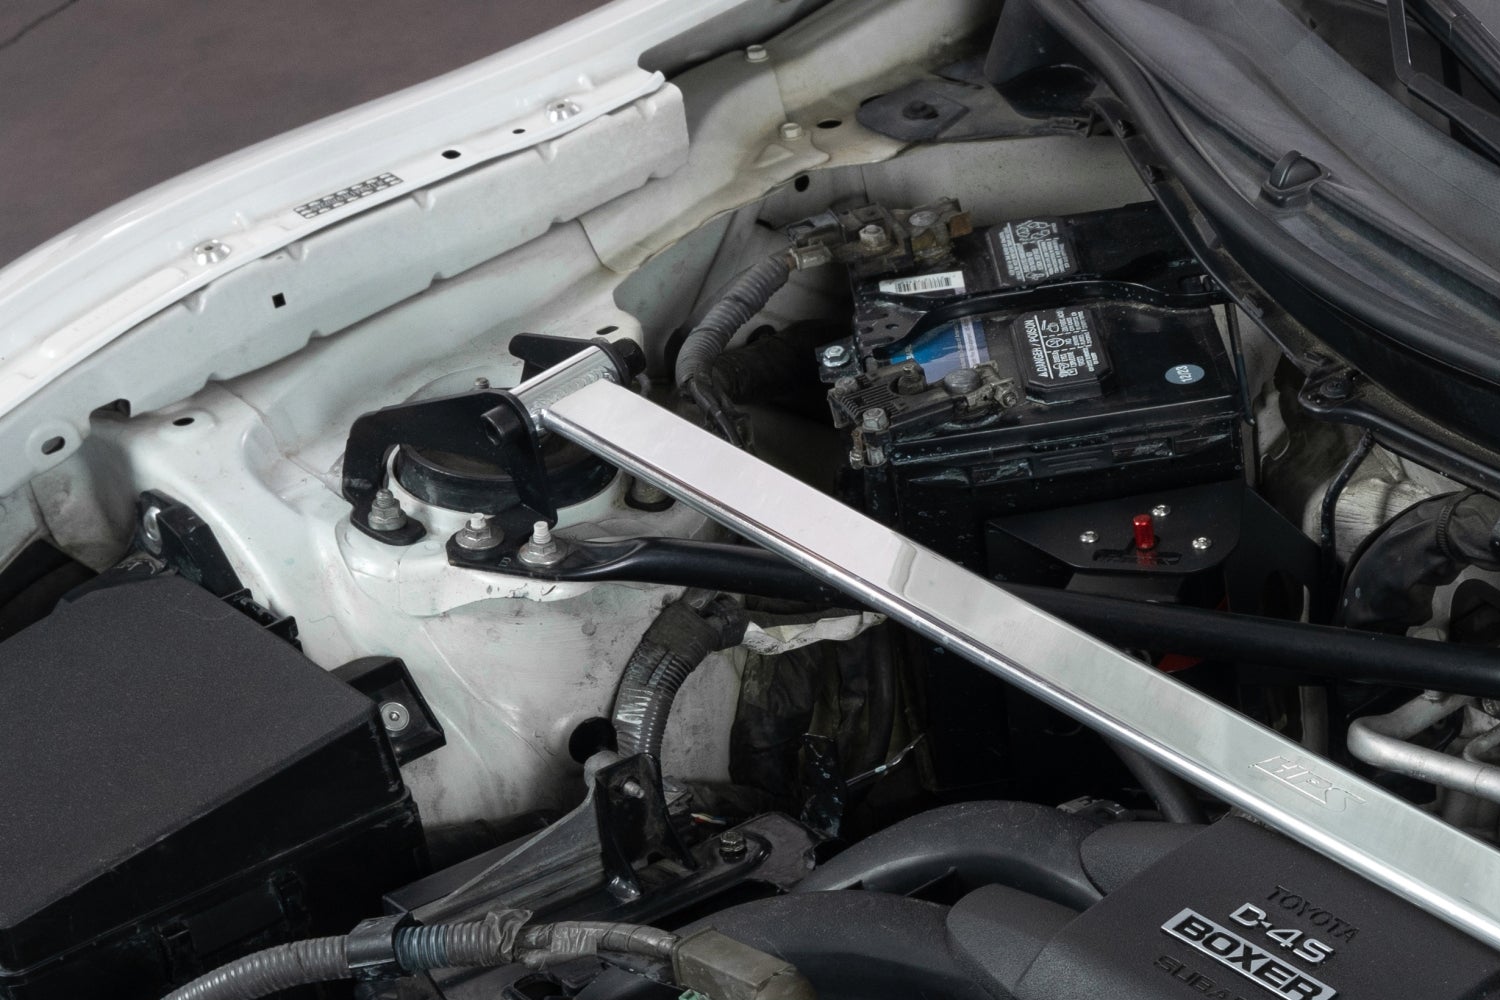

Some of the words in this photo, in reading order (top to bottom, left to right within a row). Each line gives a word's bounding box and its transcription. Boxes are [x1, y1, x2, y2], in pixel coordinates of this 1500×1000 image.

[1024, 319, 1039, 342] POISON
[1031, 347, 1047, 372] DANGER
[1175, 365, 1193, 383] 12/23
[1249, 755, 1367, 812] HPS
[1229, 903, 1335, 963] D-4S
[1266, 885, 1360, 943] TOYOTA
